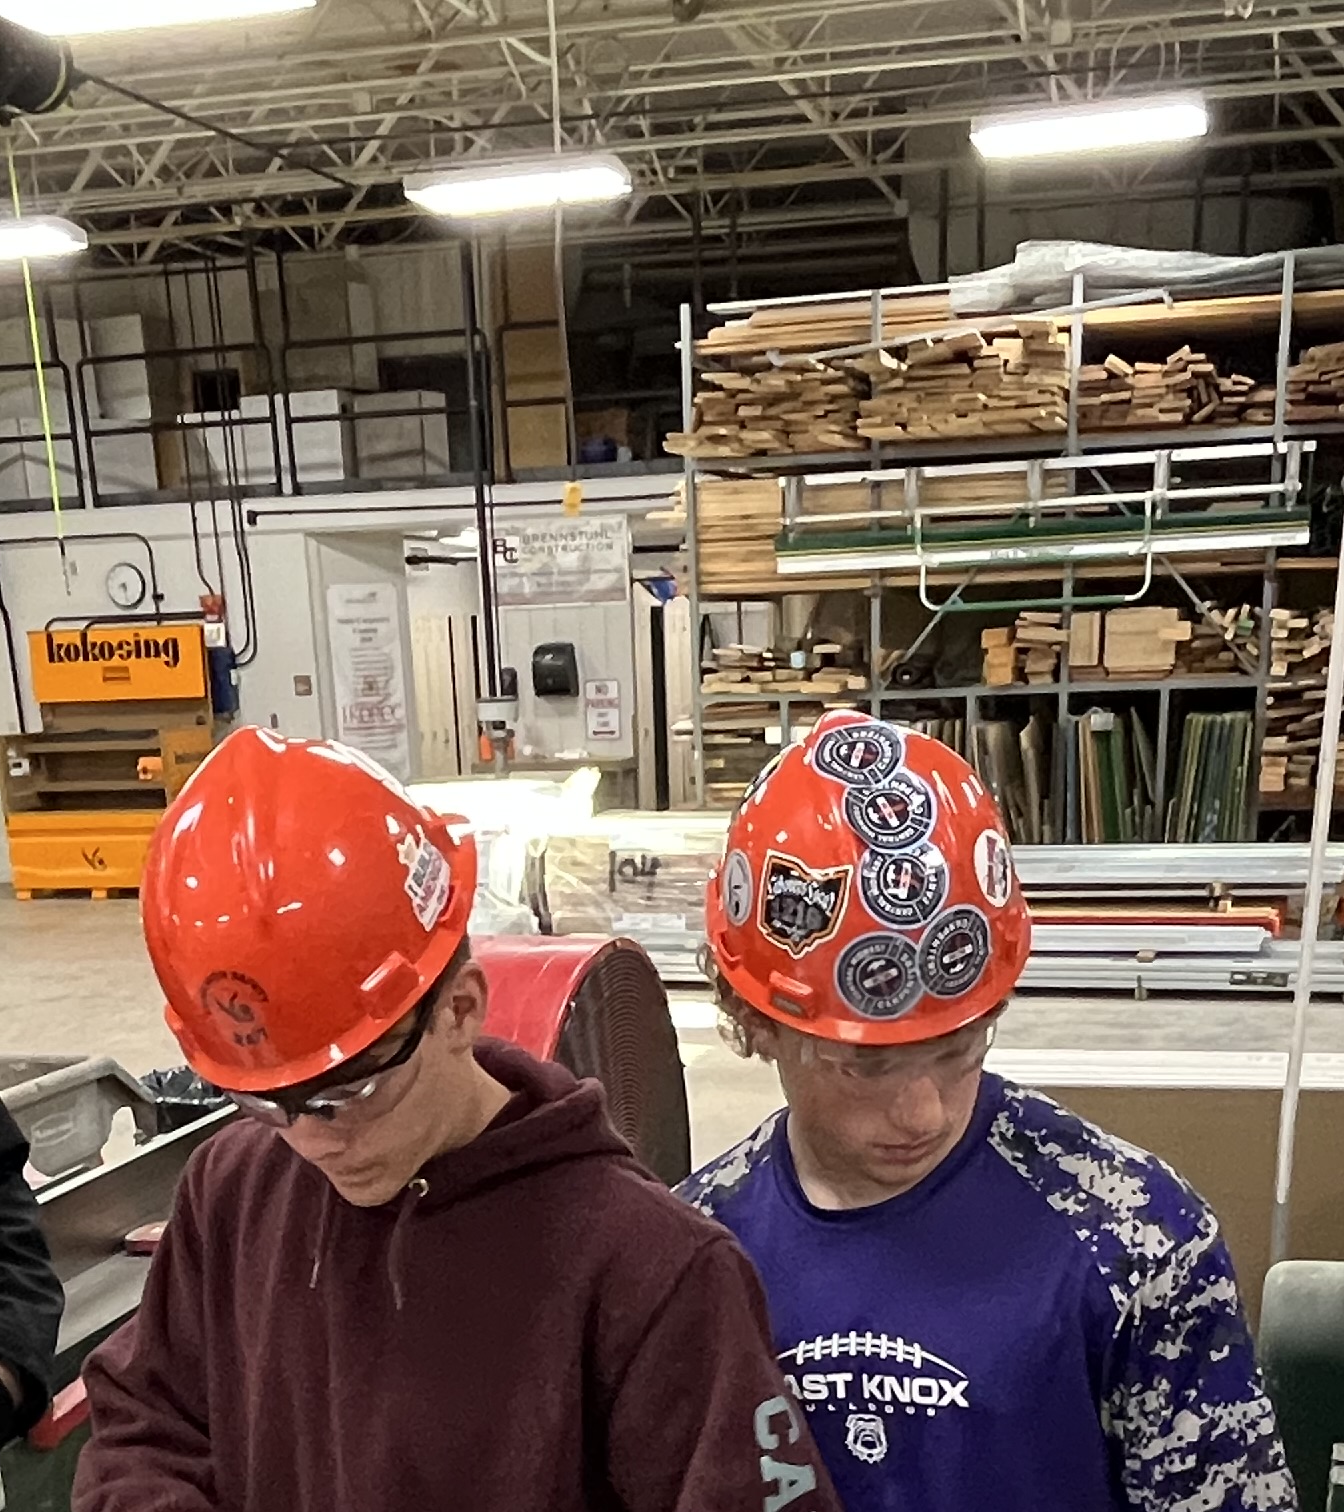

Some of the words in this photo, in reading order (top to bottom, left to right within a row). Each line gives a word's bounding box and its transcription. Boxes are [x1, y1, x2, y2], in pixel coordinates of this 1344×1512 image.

[46, 630, 180, 668] kokosing
[784, 1372, 853, 1400] AST
[862, 1372, 970, 1408] KNOX
